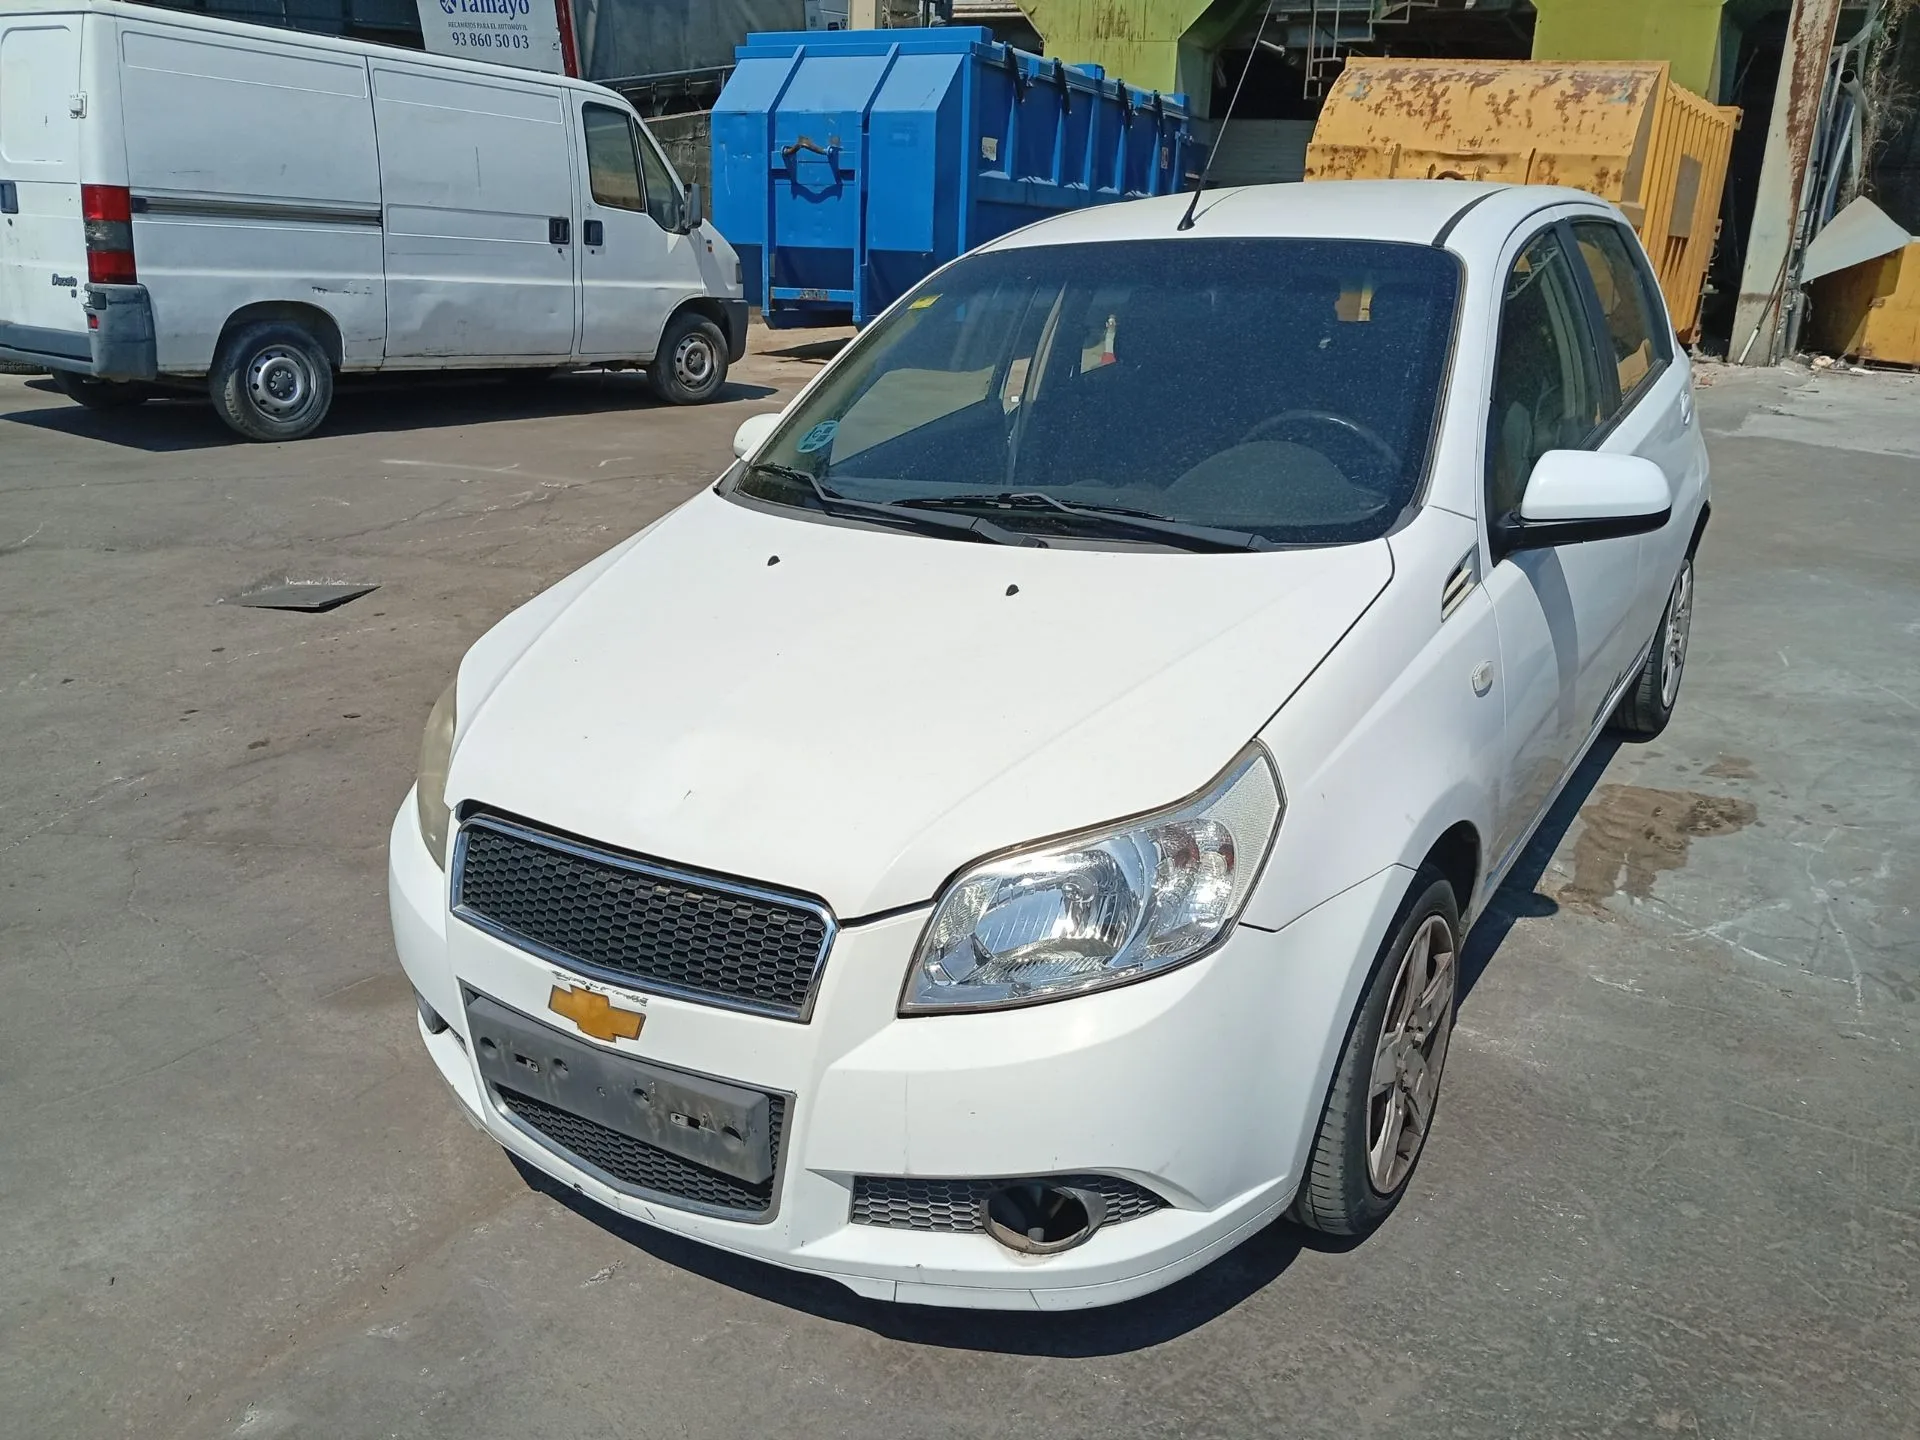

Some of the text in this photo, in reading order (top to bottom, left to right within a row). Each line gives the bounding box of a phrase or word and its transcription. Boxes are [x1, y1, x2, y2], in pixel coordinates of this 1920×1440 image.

[452, 31, 529, 49] 93 860 50 03
